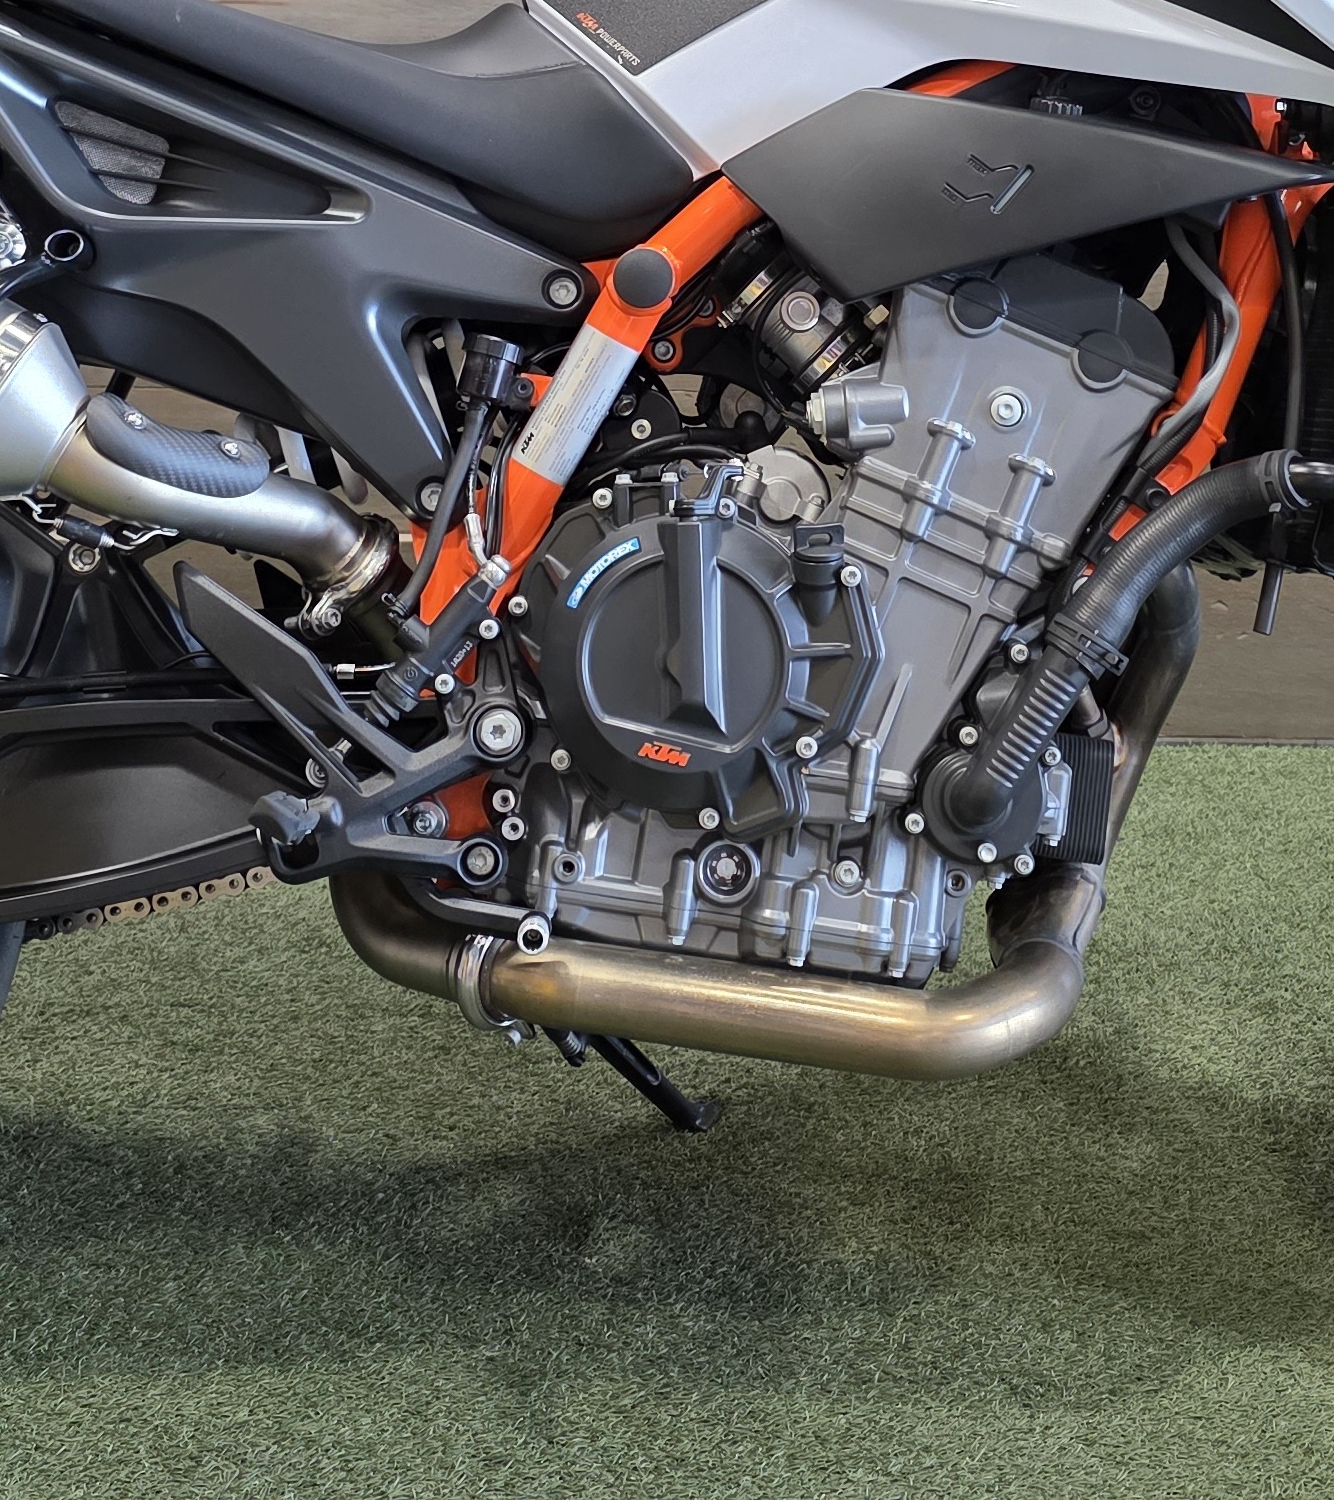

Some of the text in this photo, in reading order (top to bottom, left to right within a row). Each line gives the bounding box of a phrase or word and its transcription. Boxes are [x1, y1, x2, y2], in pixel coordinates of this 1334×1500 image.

[595, 27, 641, 66] POWERPARTS
[581, 537, 640, 587] MOTOREX
[637, 741, 691, 767] KTM
